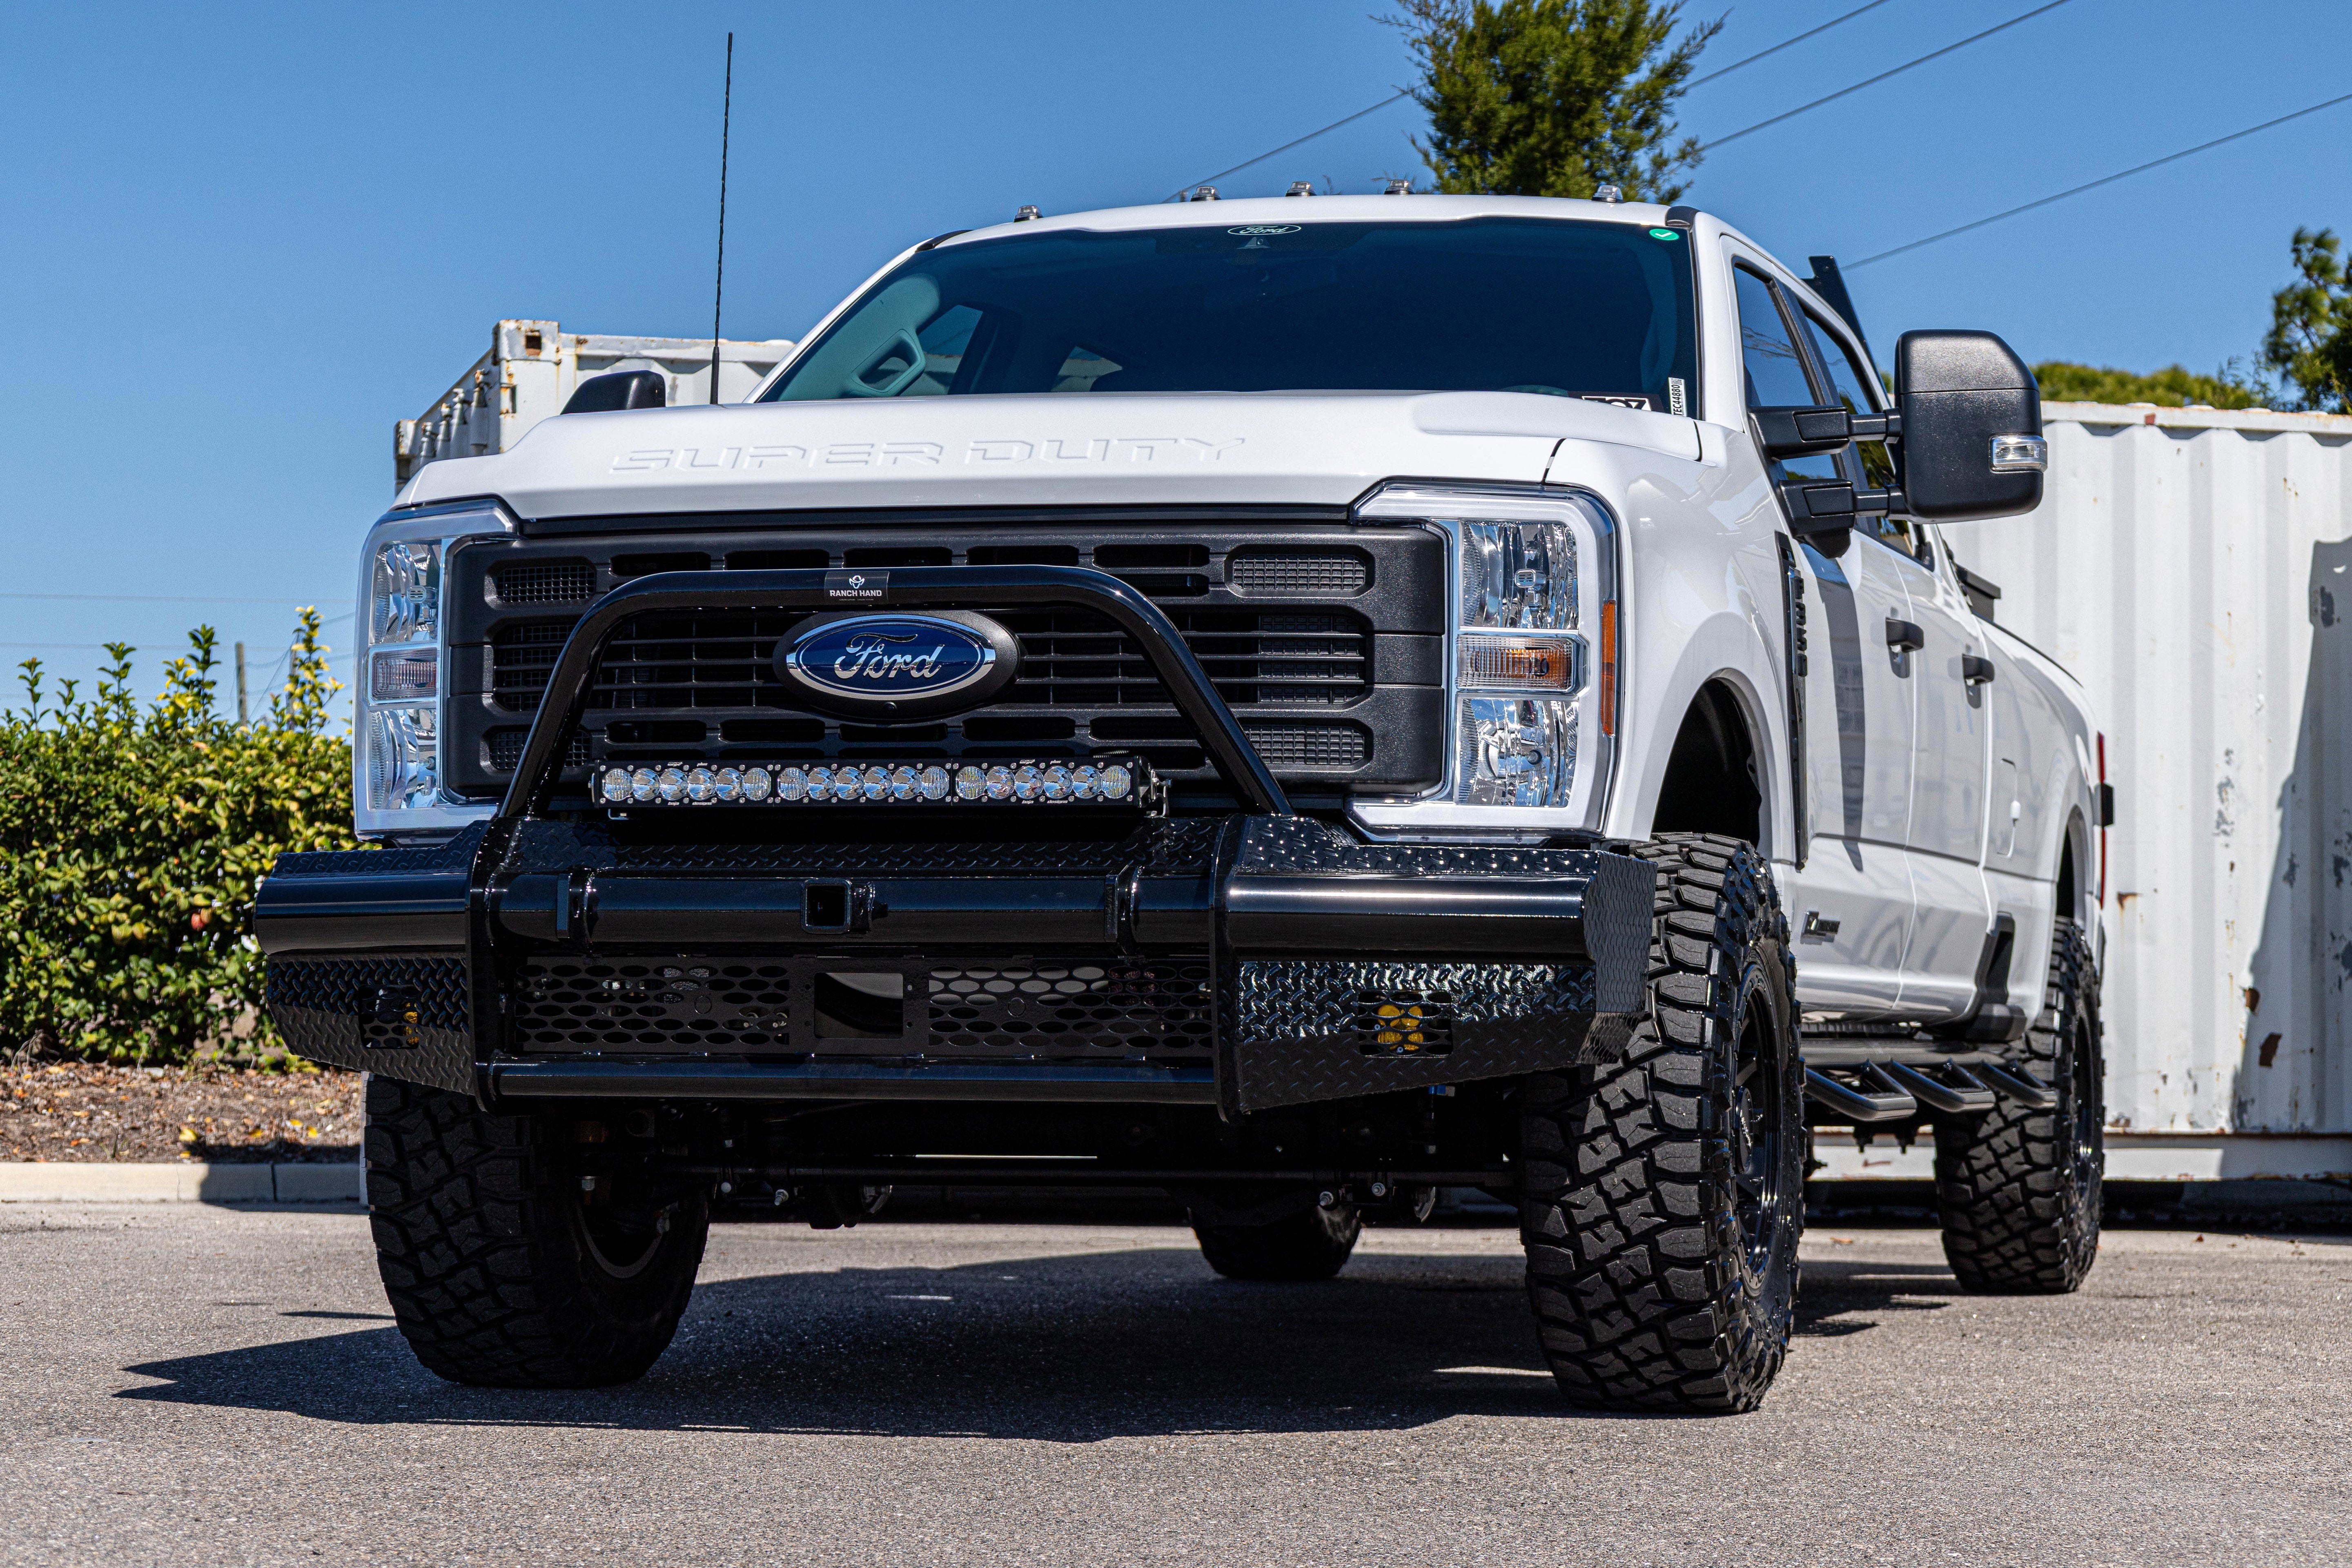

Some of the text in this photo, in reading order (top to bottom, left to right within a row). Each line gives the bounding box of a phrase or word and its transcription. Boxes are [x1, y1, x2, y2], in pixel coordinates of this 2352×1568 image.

[1240, 225, 1289, 234] Ford
[609, 438, 1245, 474] SUPER DUTY
[834, 632, 946, 679] Ford
